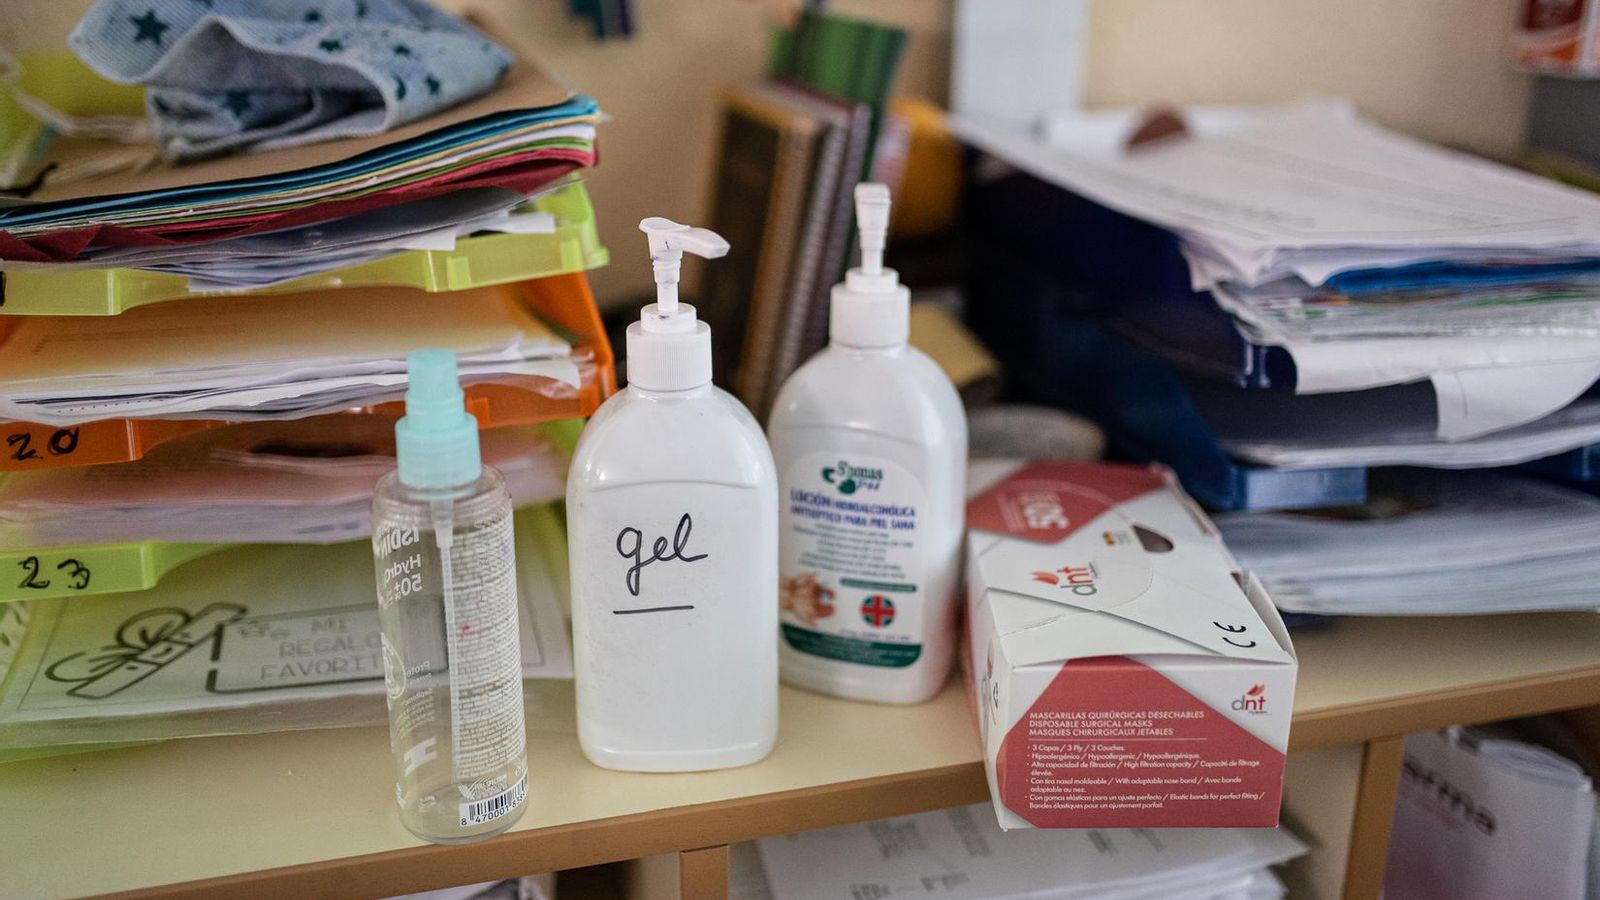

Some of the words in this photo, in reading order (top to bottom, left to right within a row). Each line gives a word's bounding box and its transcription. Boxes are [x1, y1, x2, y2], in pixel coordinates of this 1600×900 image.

[6, 427, 79, 460] 20
[616, 512, 708, 596] gel
[17, 556, 91, 590] 23
[1056, 566, 1098, 596] dnt
[259, 653, 380, 682] FAVORIT
[1030, 711, 1087, 720] MASCARILLAS
[1088, 710, 1146, 720] QUIRÚRGICAS
[1147, 711, 1205, 719] DESECHABLES
[1231, 694, 1267, 711] dnt
[1028, 728, 1071, 736] MASQUES
[1072, 728, 1135, 736] CHIRURGICAUX
[1136, 728, 1174, 736] JETABLES
[1029, 720, 1079, 728] DISPOSABLE
[1080, 720, 1121, 728] SURGICAL
[1123, 719, 1153, 727] MASKS
